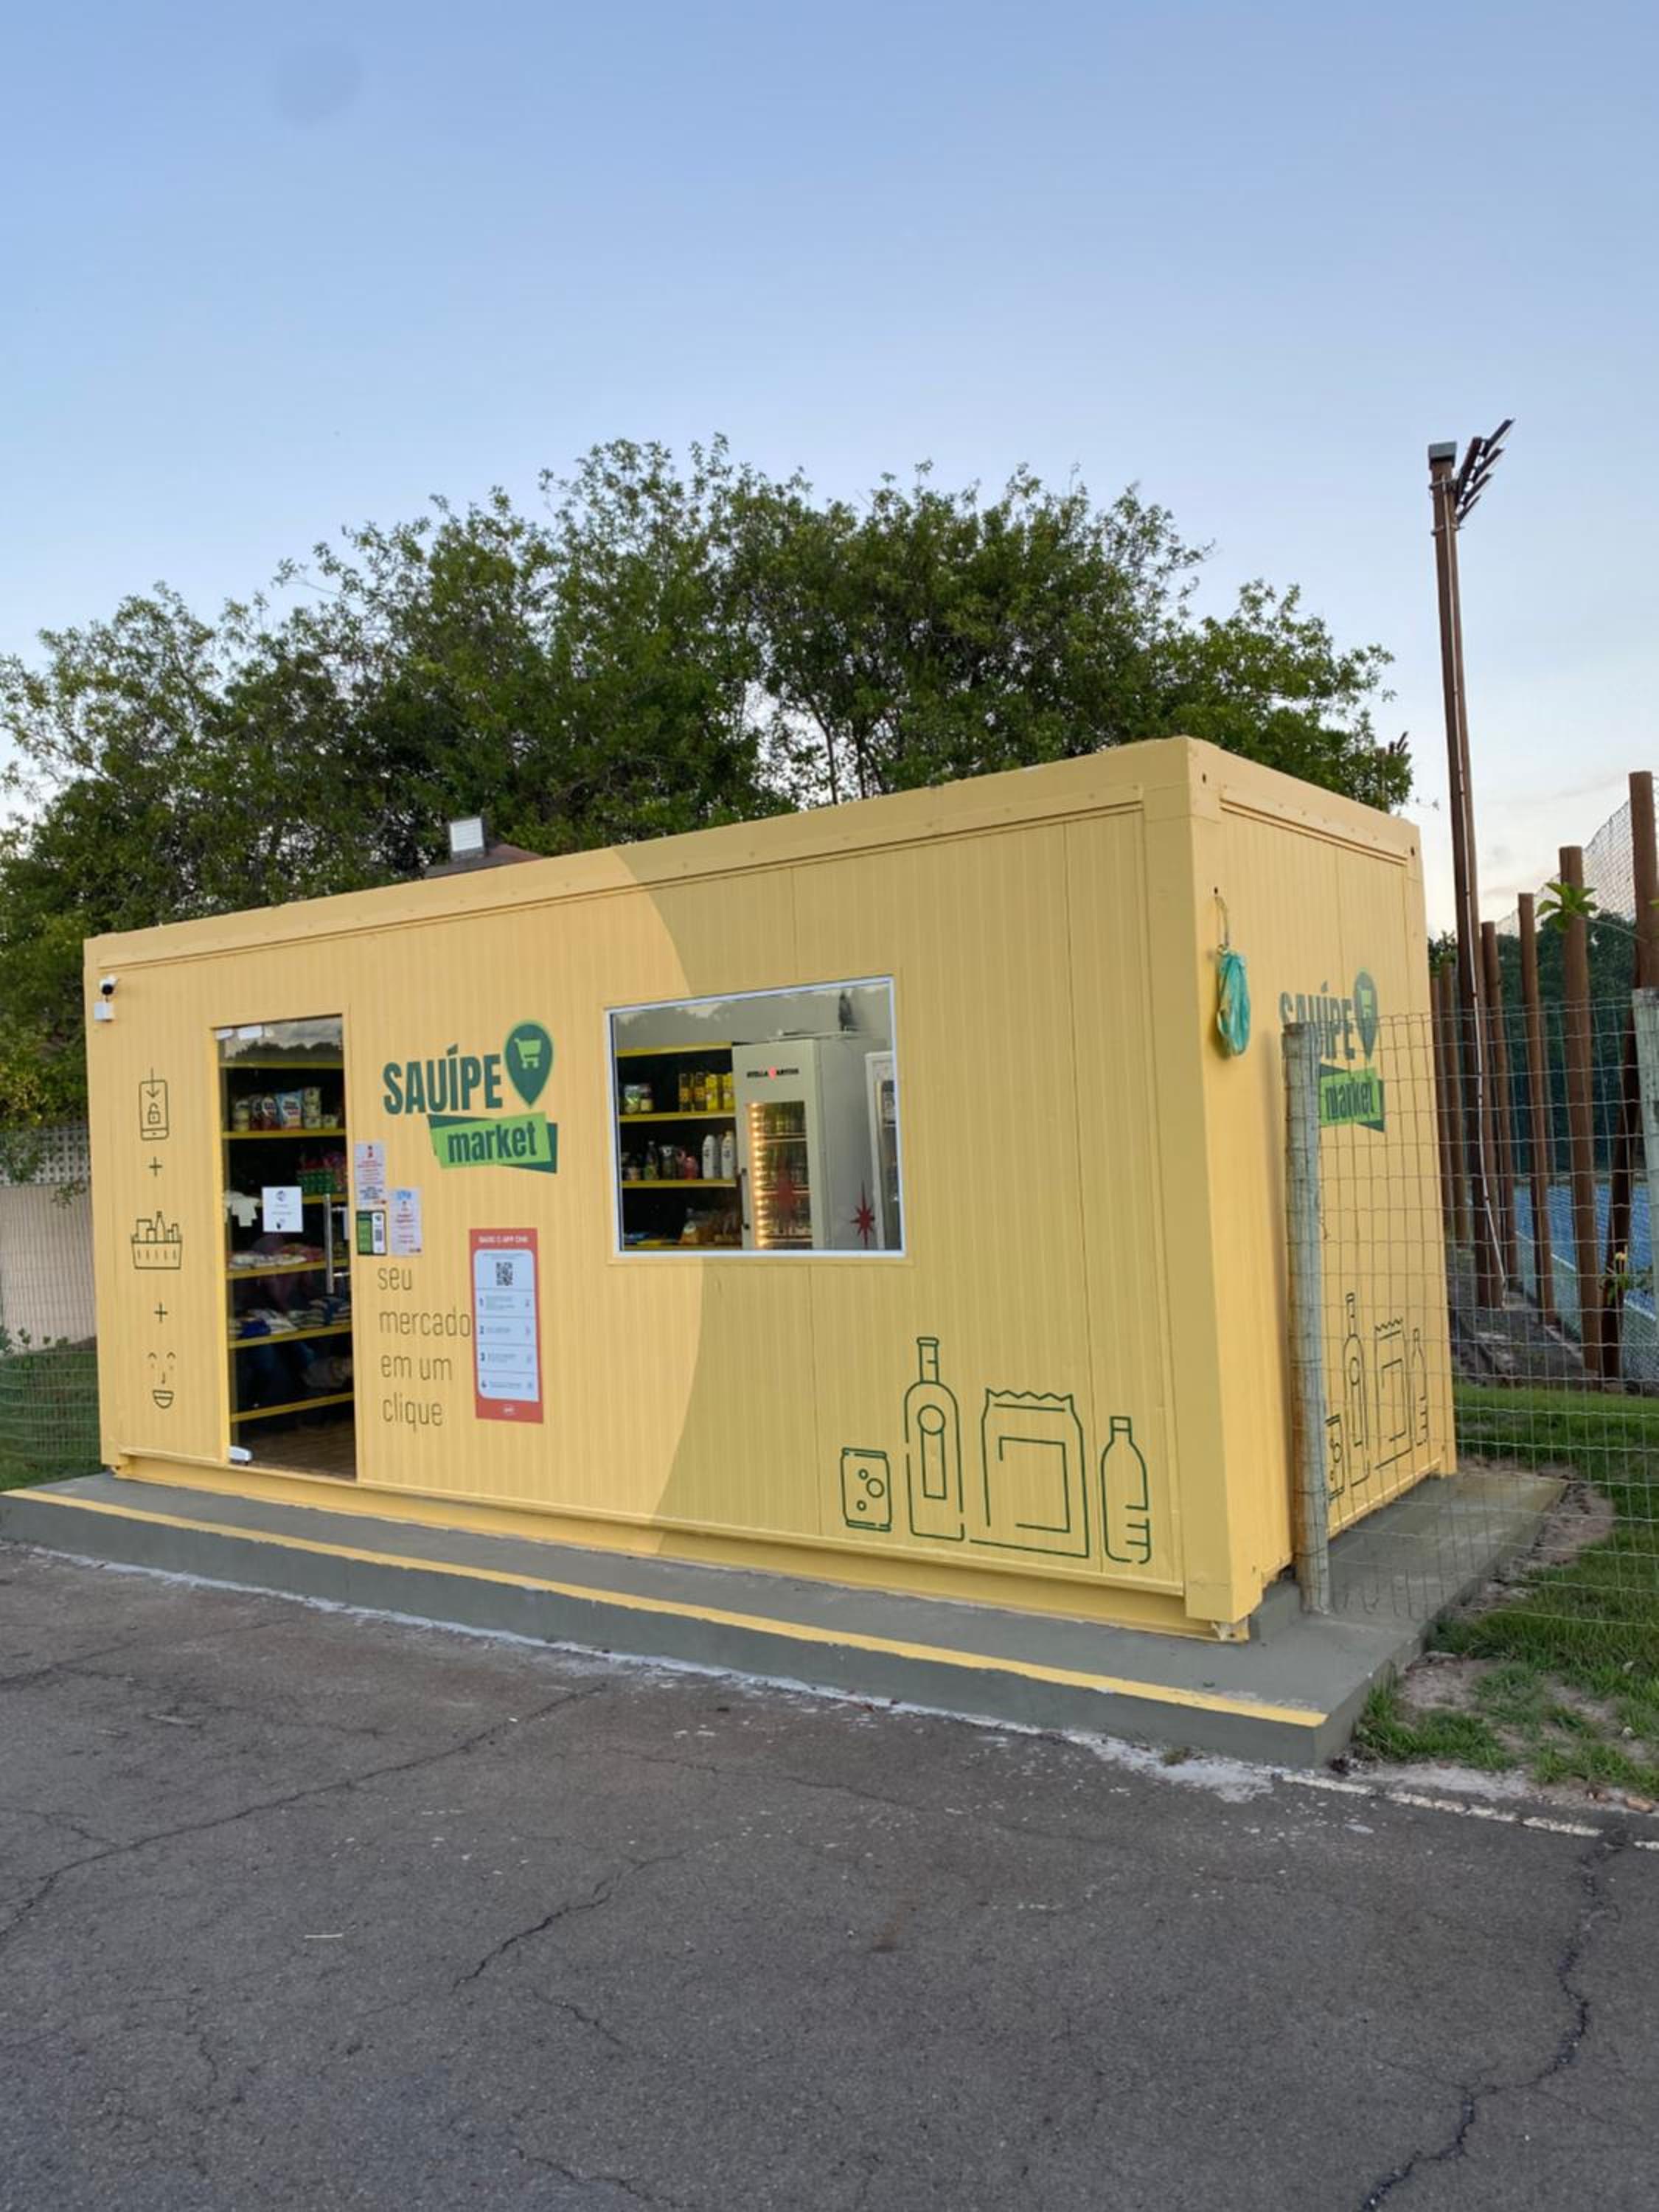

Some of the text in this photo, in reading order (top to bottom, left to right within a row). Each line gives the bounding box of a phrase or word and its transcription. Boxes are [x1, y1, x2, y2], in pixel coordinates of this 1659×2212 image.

[383, 1043, 503, 1114] SAUÍPE
[447, 1121, 537, 1163] market
[377, 1266, 412, 1290] seu
[378, 1306, 471, 1337] mercado
[380, 1354, 453, 1381] em um
[382, 1392, 442, 1433] clique
